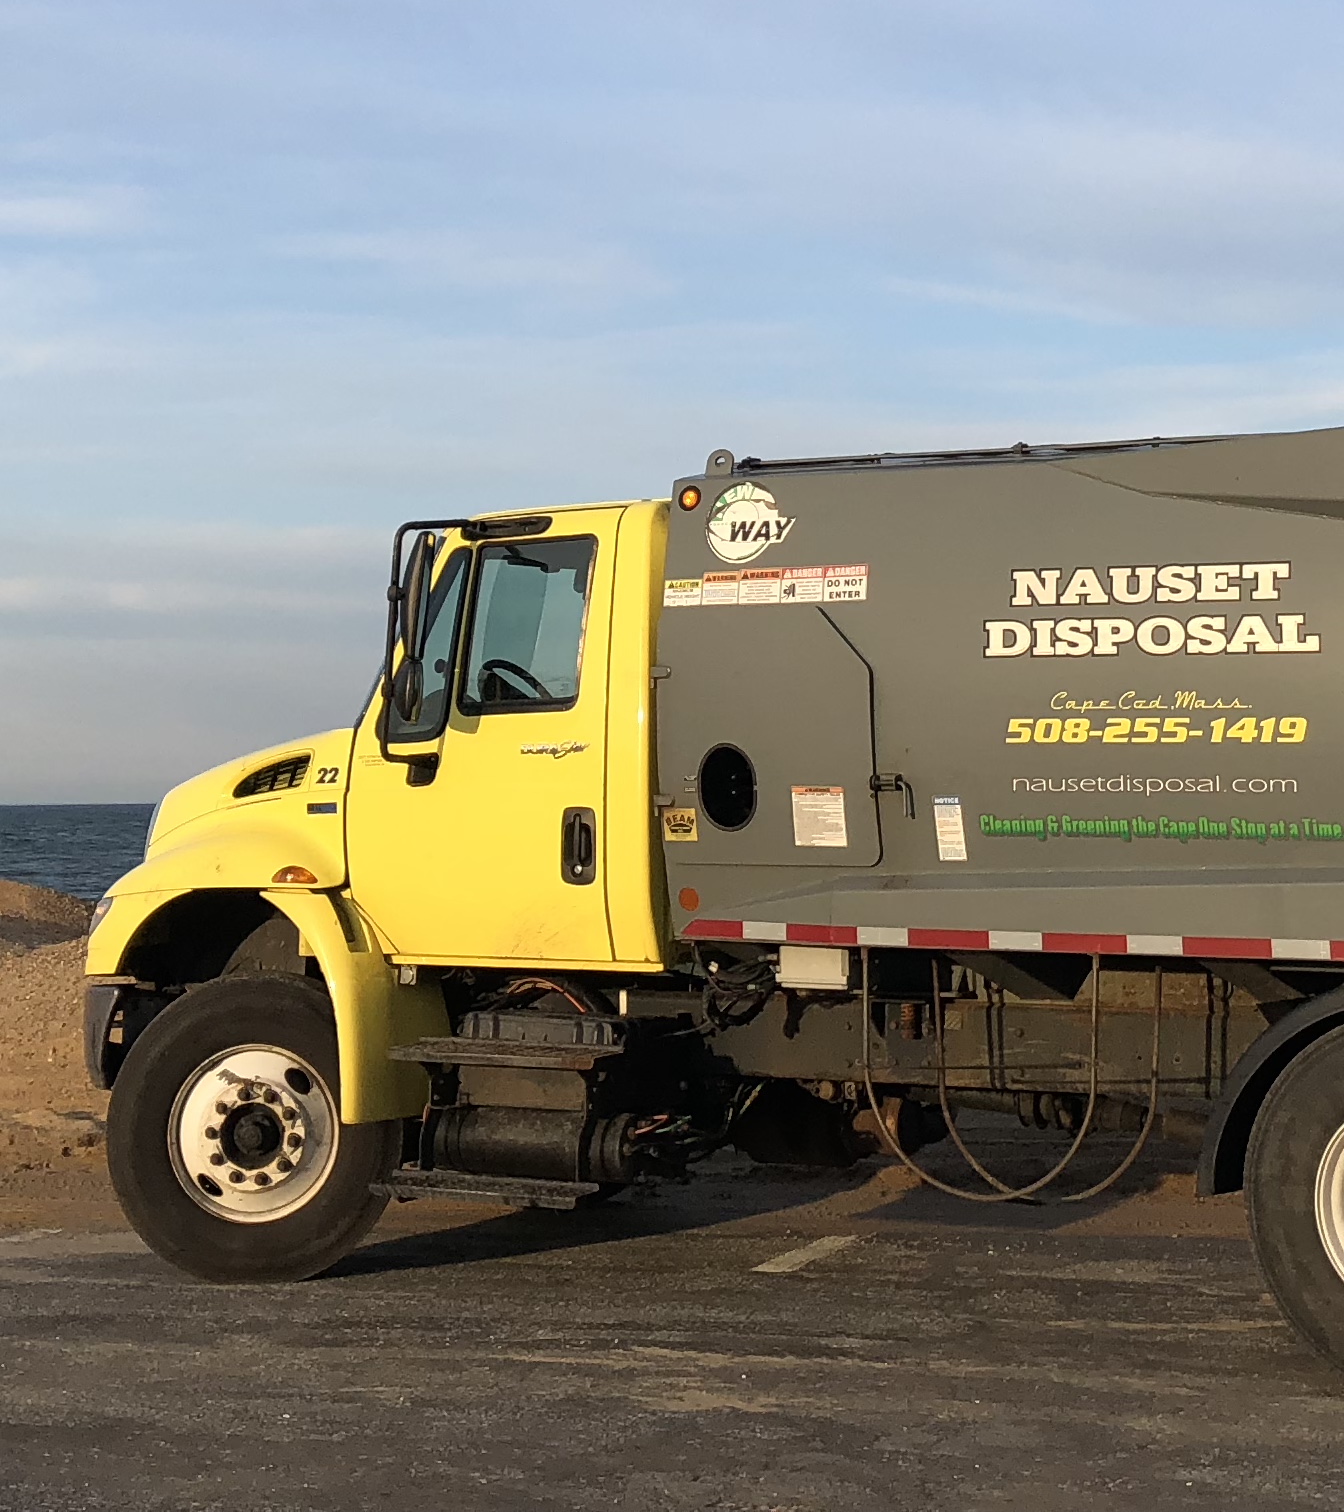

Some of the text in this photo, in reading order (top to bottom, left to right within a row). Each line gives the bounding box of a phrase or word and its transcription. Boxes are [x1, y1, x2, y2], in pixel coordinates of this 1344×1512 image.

[729, 518, 791, 542] WAY
[836, 565, 866, 576] DANGER
[827, 578, 863, 588] DO NOT
[1010, 561, 1291, 607] NAUSET
[829, 590, 861, 599] ENTER
[982, 613, 1322, 658] DISPOSAL
[1050, 691, 1116, 713] Cape
[1006, 716, 1308, 744] 508-255-1419
[316, 767, 340, 784] 22
[1012, 774, 1298, 797] nausetdisposal.com
[934, 796, 959, 804] NOTICE
[979, 814, 1046, 841] Cleaning
[1047, 814, 1060, 836] &
[1061, 814, 1131, 842] Greening
[1132, 816, 1157, 837] the
[1158, 816, 1198, 844] Cape
[1198, 816, 1228, 839] One
[1229, 817, 1267, 845] Stop
[1269, 819, 1287, 840] at
[1289, 822, 1301, 840] a
